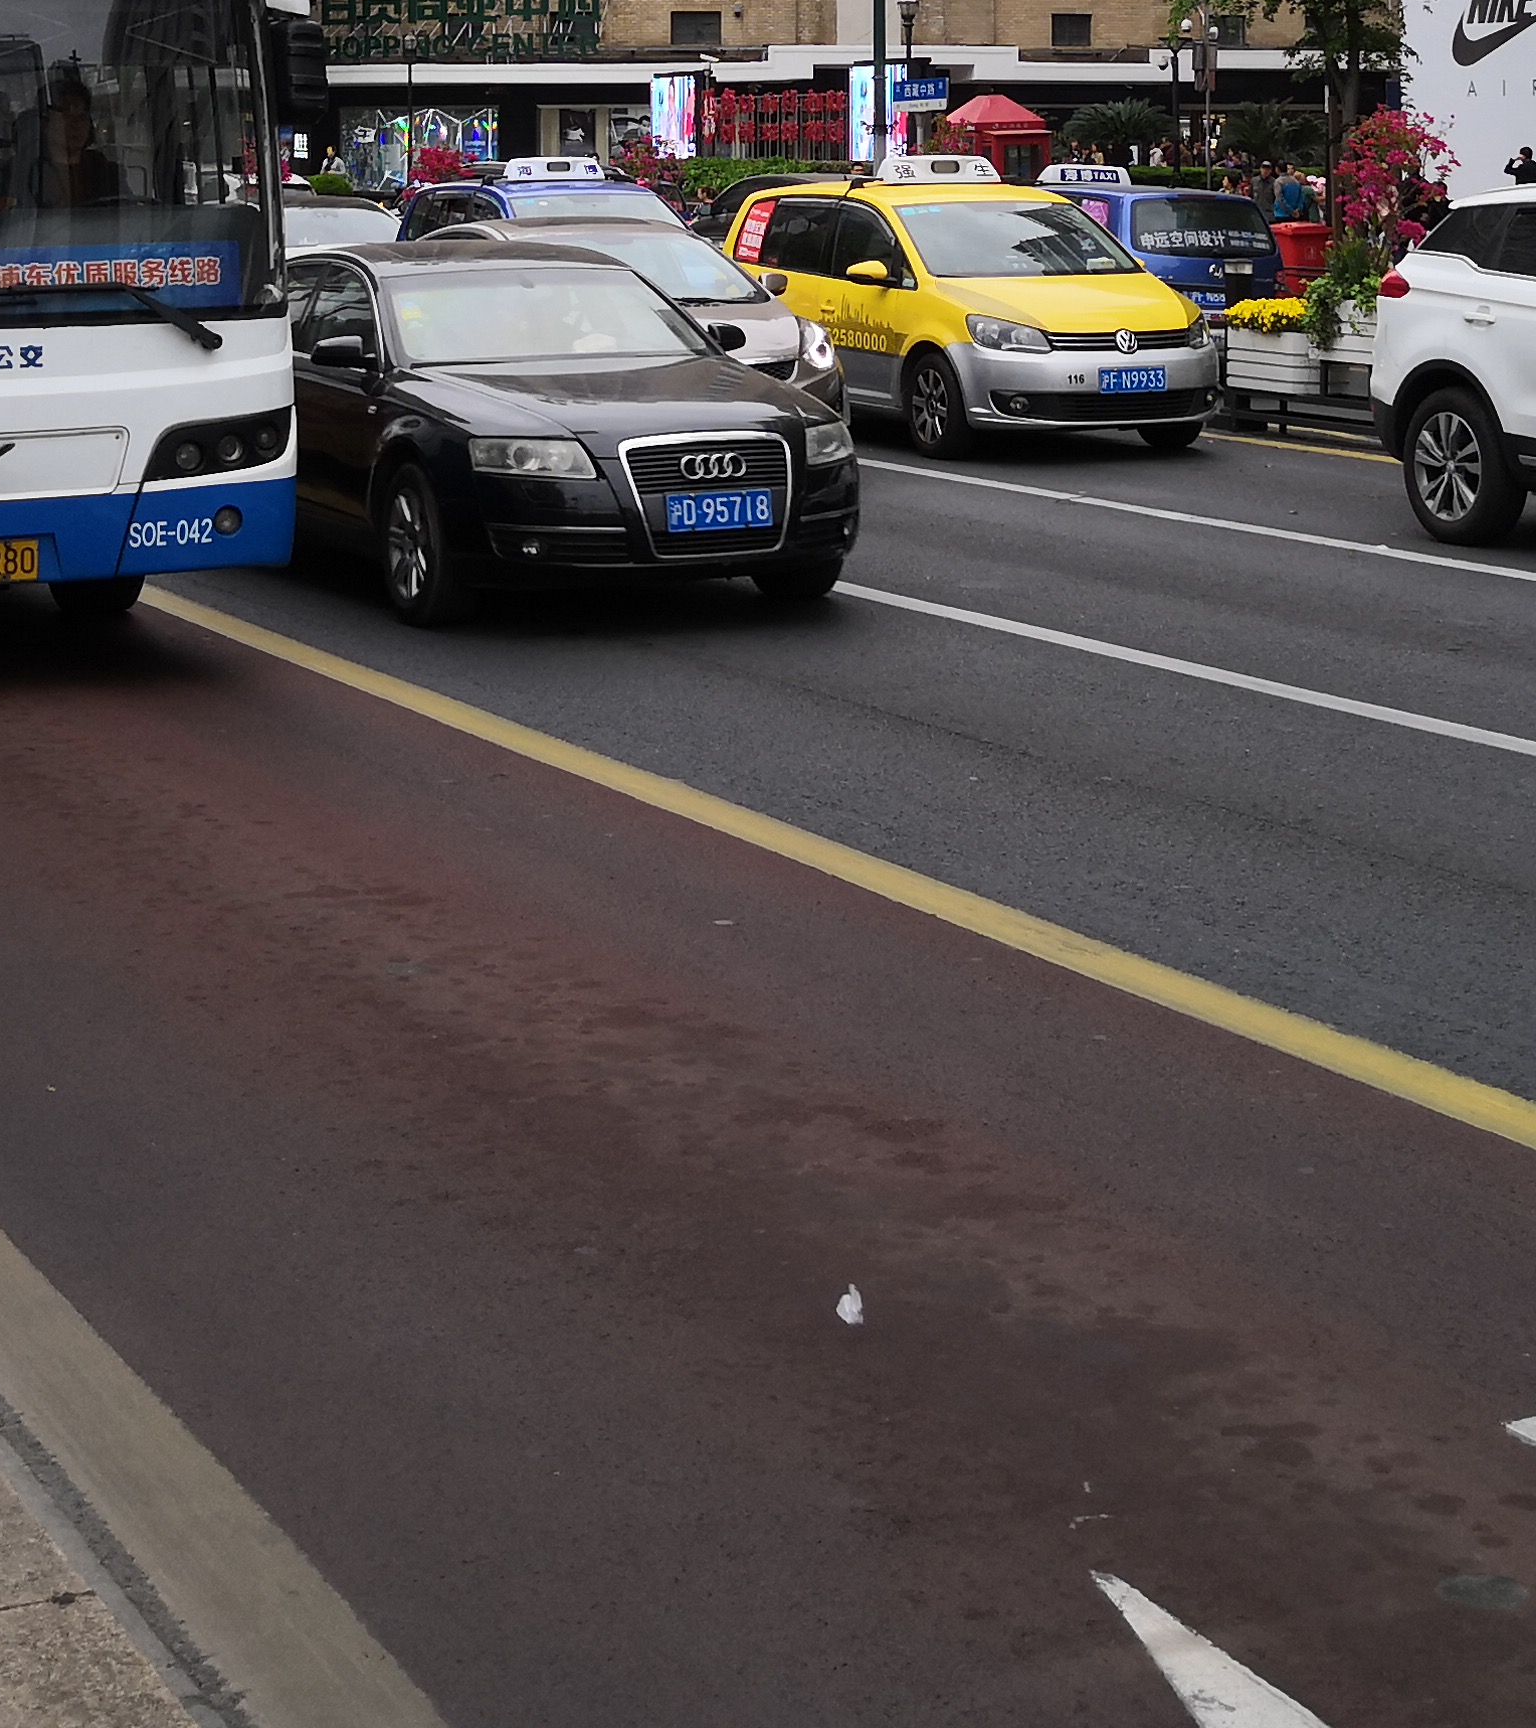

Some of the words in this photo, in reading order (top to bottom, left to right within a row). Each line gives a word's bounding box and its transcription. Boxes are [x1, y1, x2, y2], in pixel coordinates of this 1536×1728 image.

[904, 83, 935, 98] 西藏中路
[1067, 374, 1086, 385] 116
[128, 517, 214, 549] SOE-042
